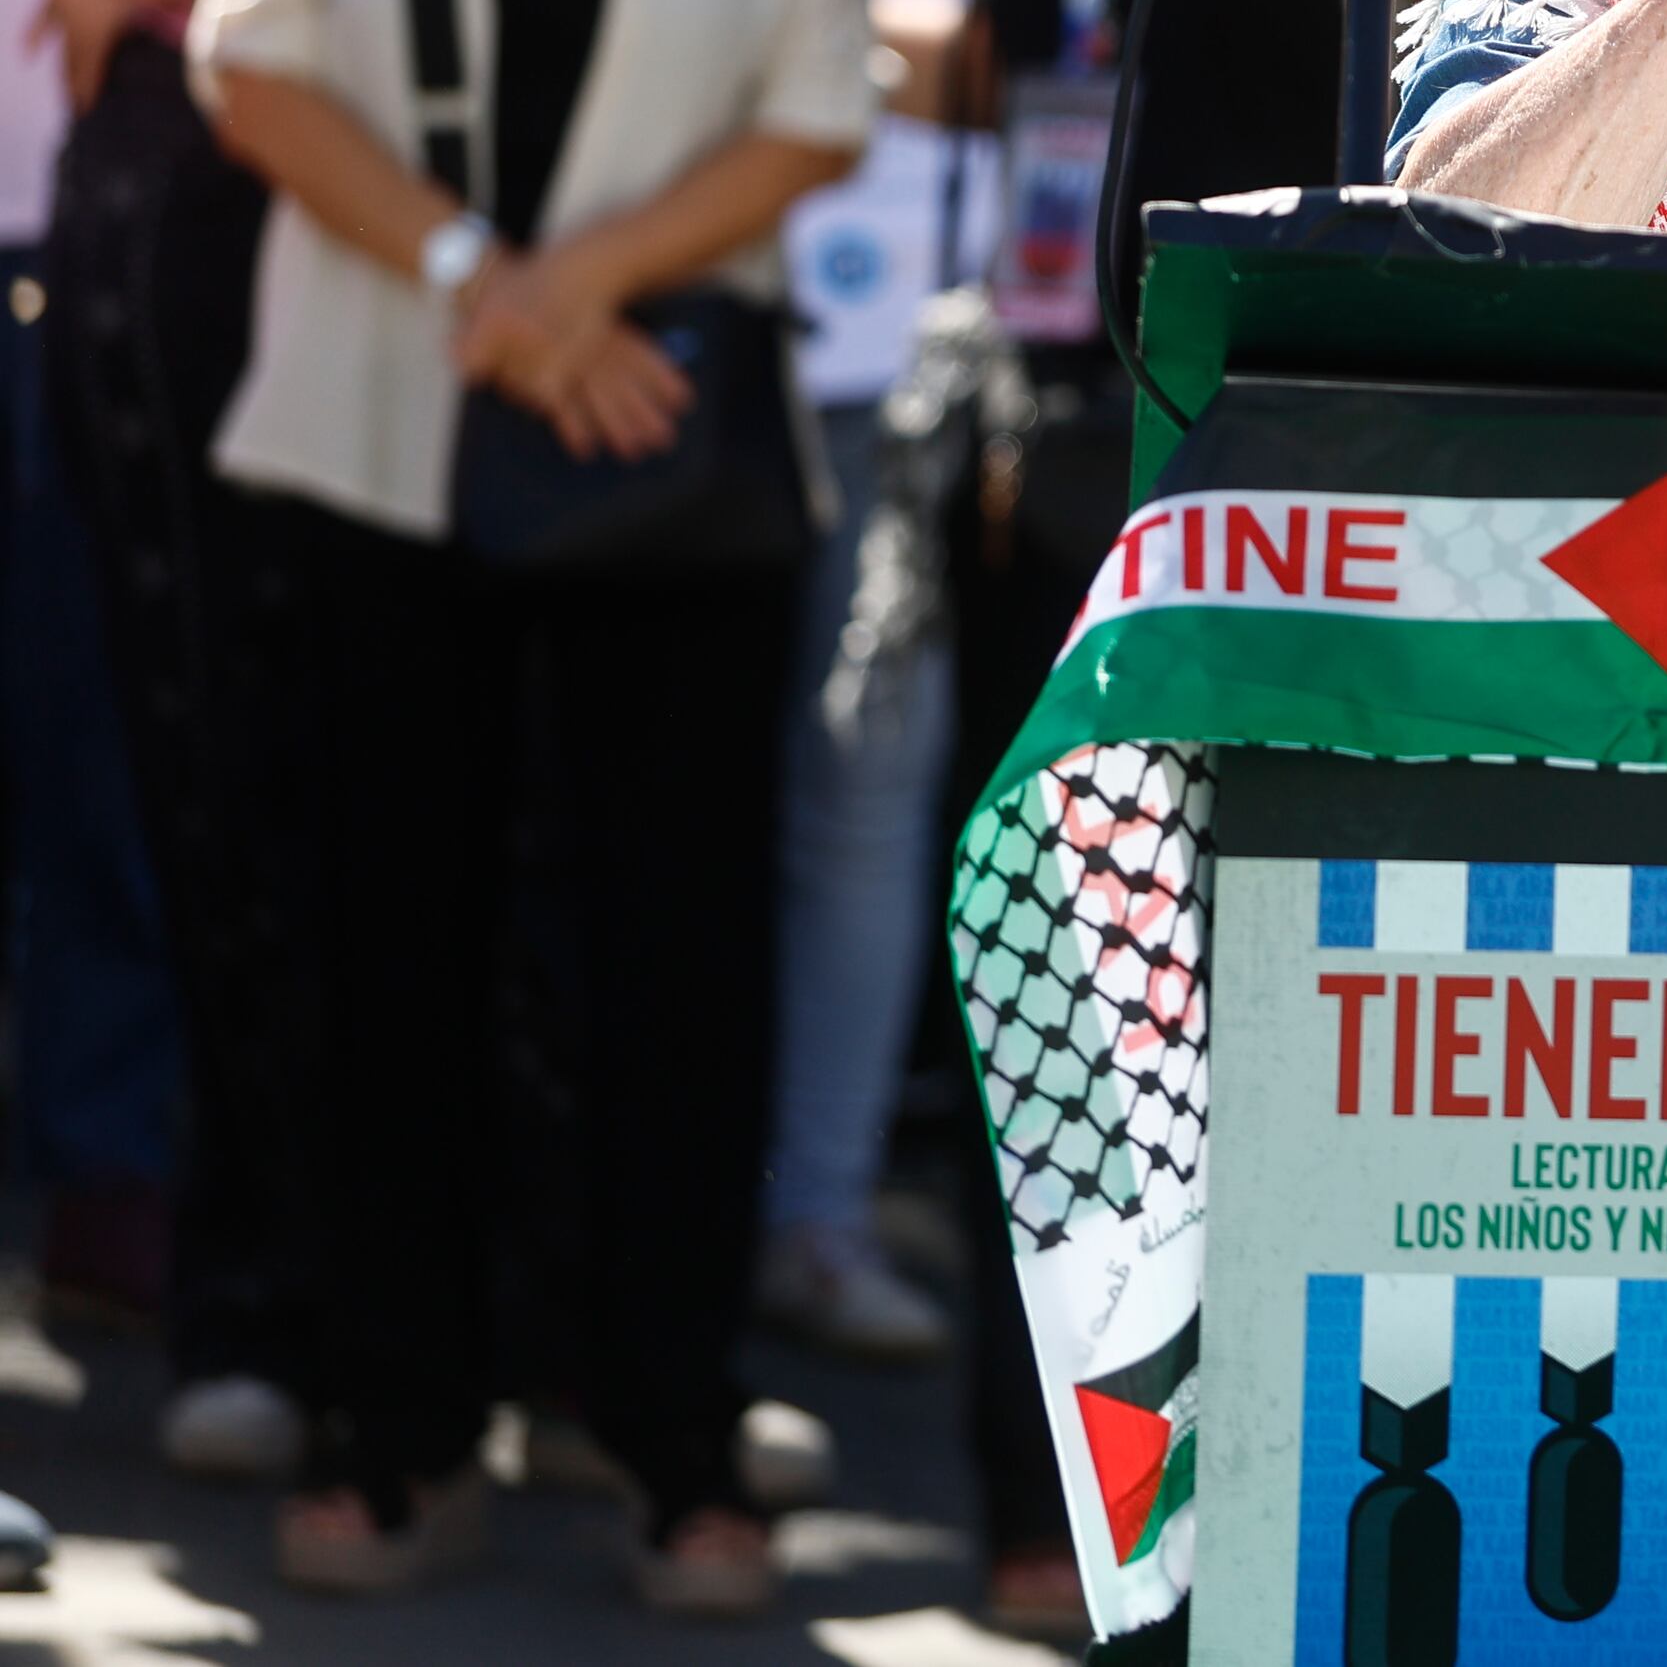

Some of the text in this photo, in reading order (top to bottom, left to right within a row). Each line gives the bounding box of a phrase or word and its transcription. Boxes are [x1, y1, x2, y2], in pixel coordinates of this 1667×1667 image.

[1394, 1201, 1467, 1251] LOS
[1477, 1197, 1592, 1253] NIÑOS
[1604, 1208, 1628, 1252] Y
